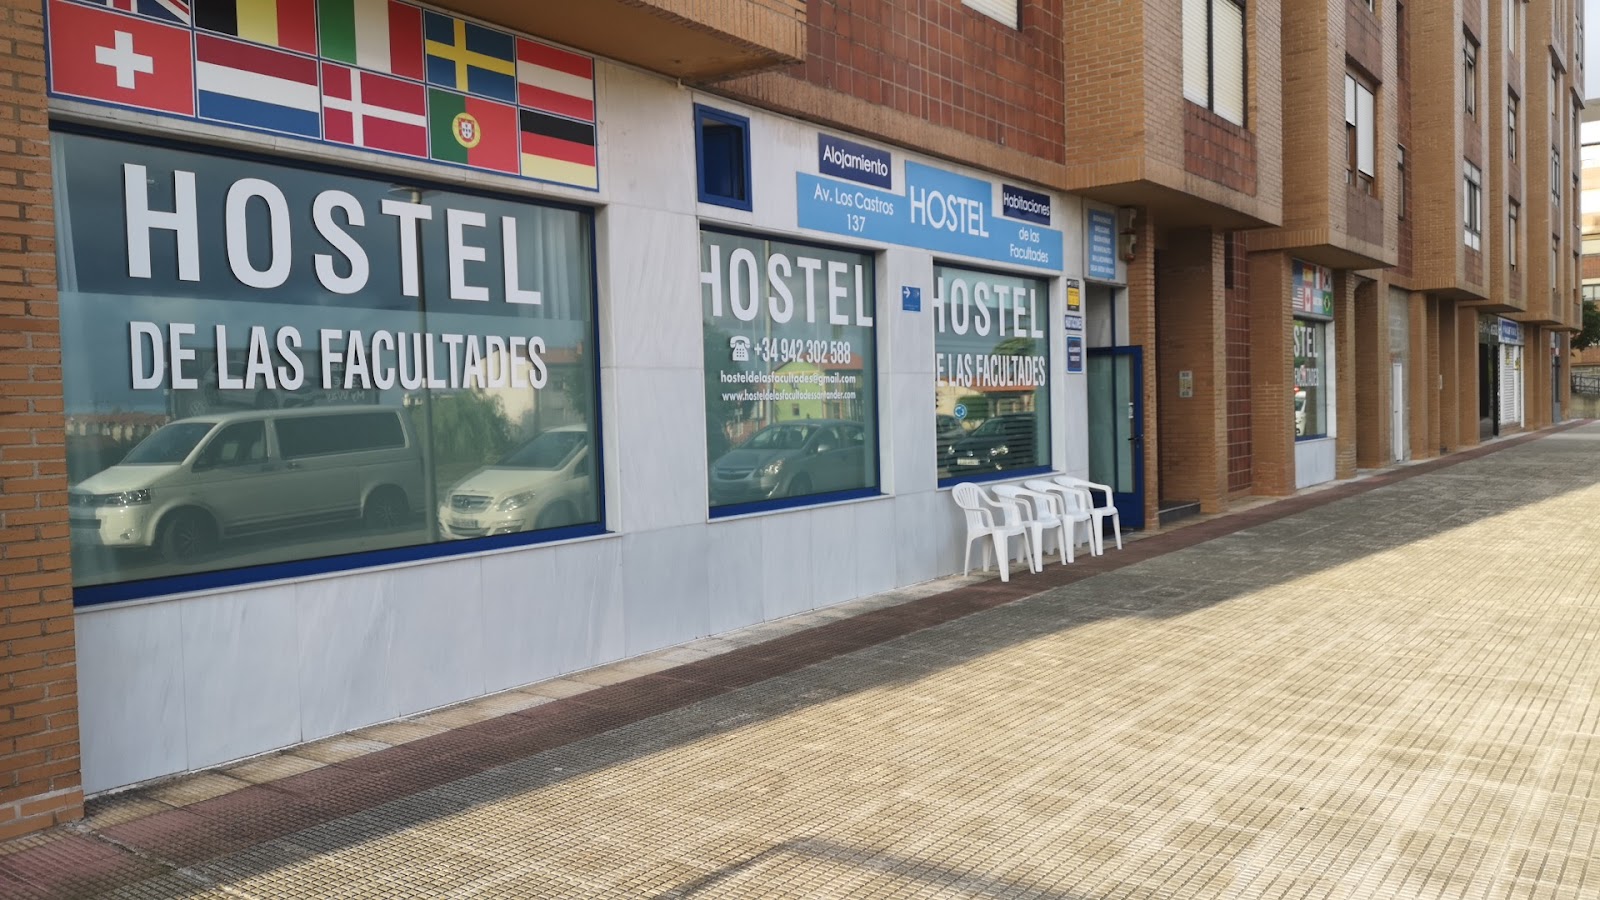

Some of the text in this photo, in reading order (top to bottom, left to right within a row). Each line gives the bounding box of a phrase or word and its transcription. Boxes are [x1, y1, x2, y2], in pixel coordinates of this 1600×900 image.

[822, 144, 888, 177] Alojamiento
[813, 183, 894, 217] Av. Los Castros
[909, 185, 990, 239] HOSTEL
[1003, 191, 1050, 217] Habitaciones
[123, 162, 542, 305] HOSTEL
[846, 213, 866, 232] 137
[1018, 227, 1041, 243] de las
[1009, 243, 1049, 264] Facultades
[700, 244, 873, 327] HOSTEL
[932, 276, 1044, 339] HOSTEL
[129, 320, 548, 391] DE LAS FACULTADES
[753, 337, 851, 365] +34 942 302 588
[1294, 325, 1318, 358] STEL
[720, 370, 856, 385] hosteldelasfacultades@gmail.com
[936, 352, 1046, 388] E LAS FACULTADES
